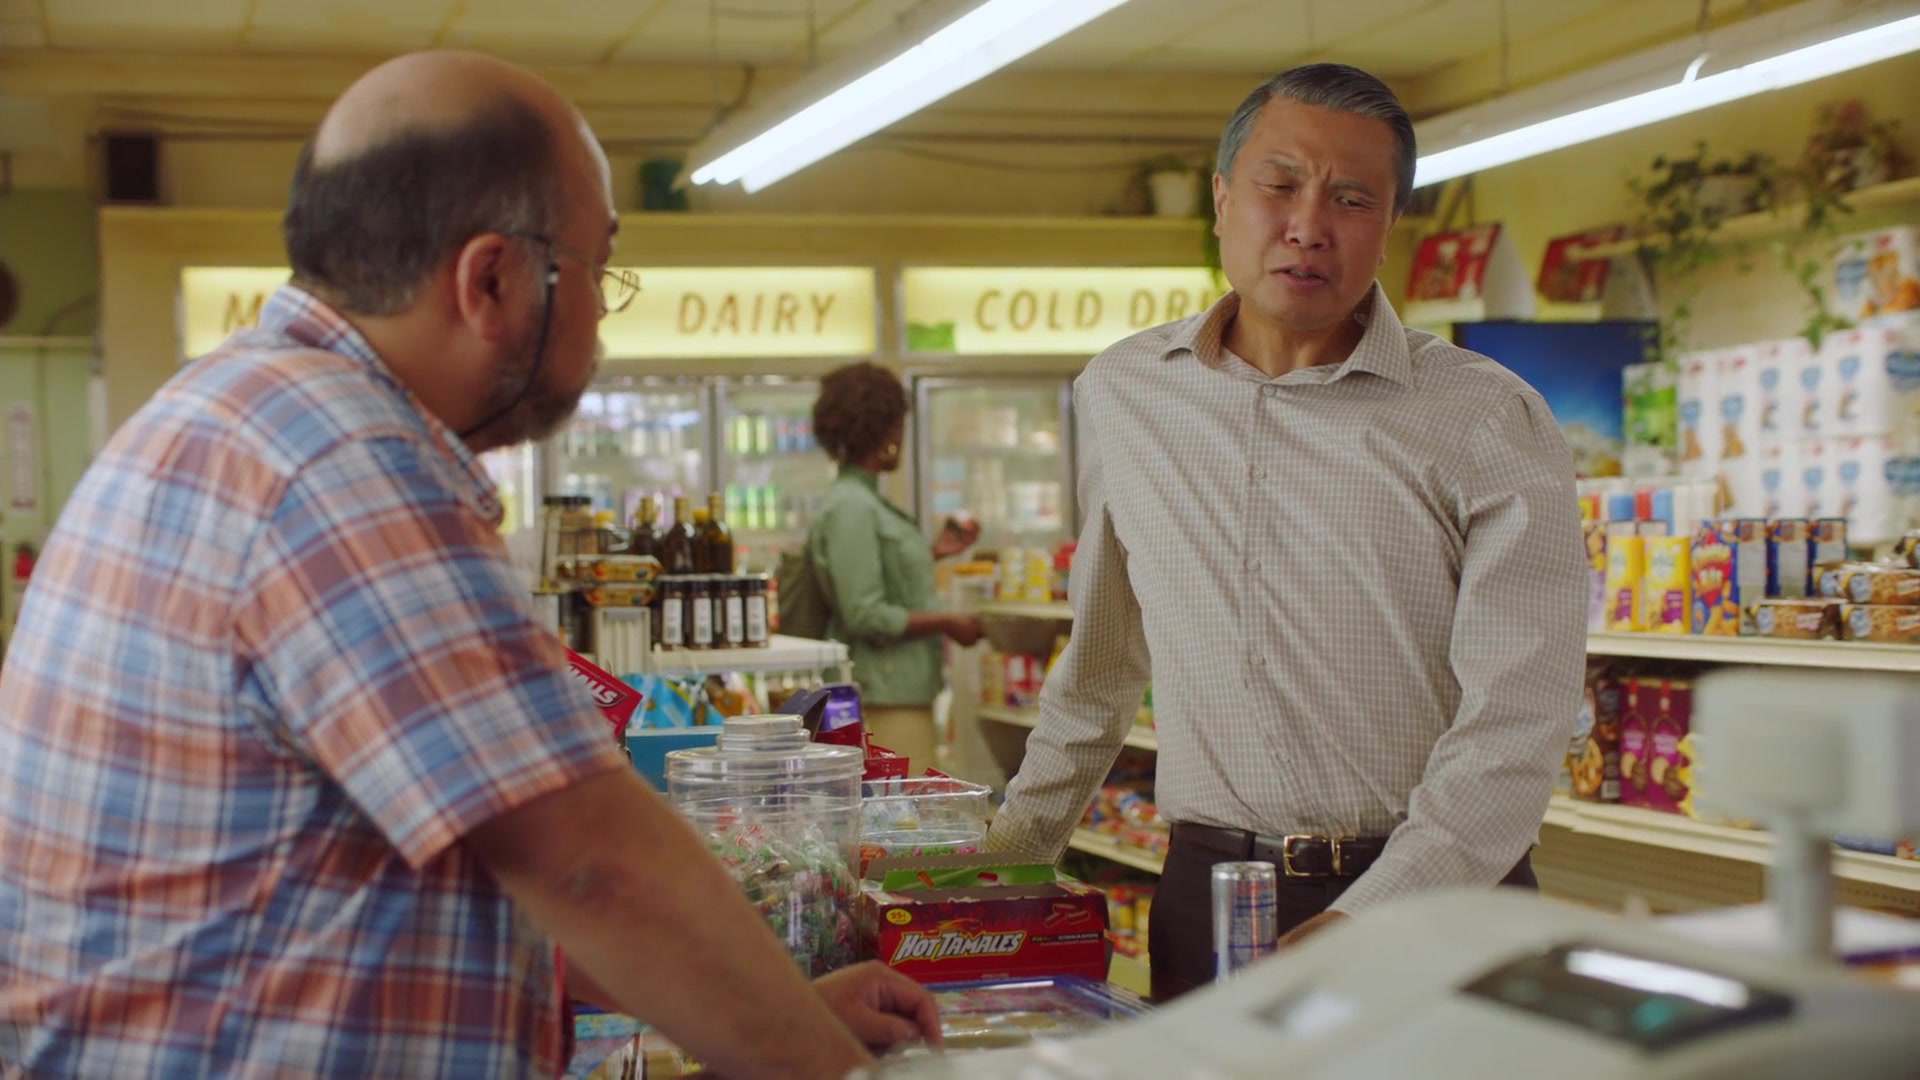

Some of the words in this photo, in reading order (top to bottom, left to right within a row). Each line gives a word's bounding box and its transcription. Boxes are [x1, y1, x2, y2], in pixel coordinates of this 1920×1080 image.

[223, 293, 265, 334] M
[678, 292, 836, 334] DAIRY
[974, 288, 1104, 332] COLD
[1129, 288, 1211, 328] DRI
[937, 931, 1024, 957] TAMALES
